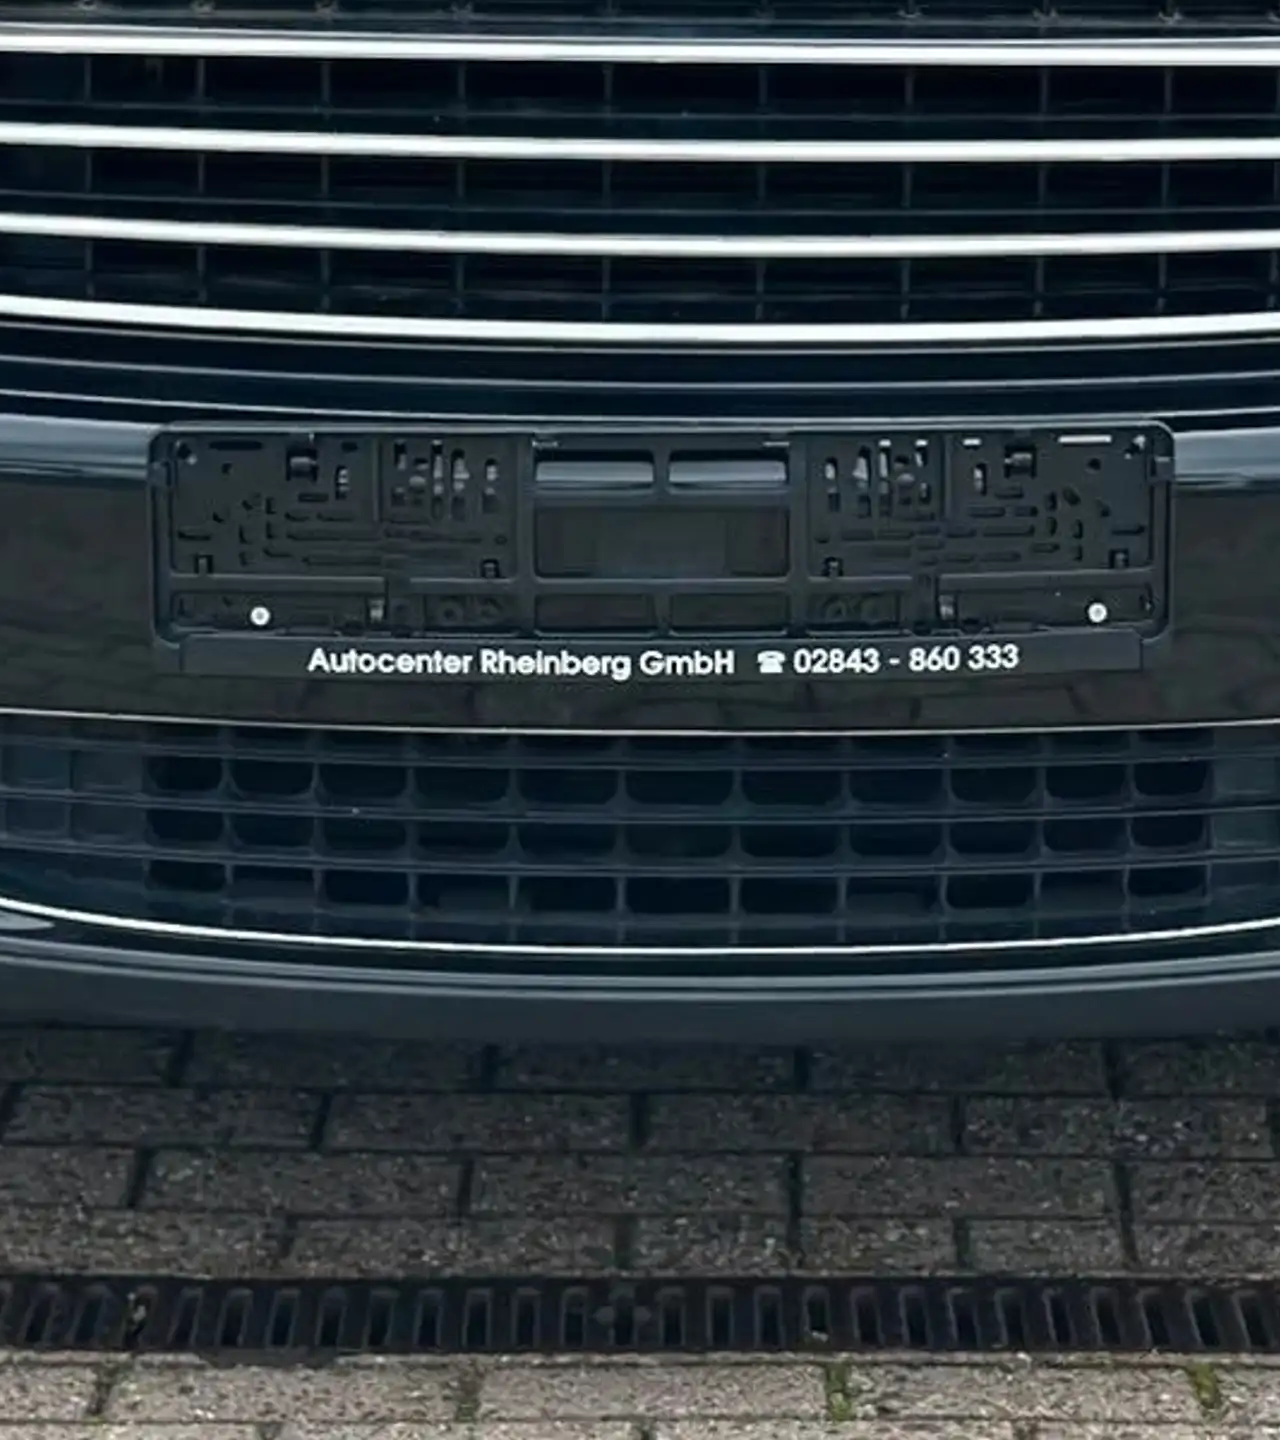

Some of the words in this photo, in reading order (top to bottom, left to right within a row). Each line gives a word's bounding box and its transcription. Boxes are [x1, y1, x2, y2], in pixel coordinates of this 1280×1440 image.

[307, 647, 473, 675] Autocenter
[480, 648, 632, 682] Rheinberg
[639, 649, 735, 676] GmbH
[793, 648, 881, 674] 02843
[909, 646, 962, 673] 860
[968, 644, 1019, 671] 333
